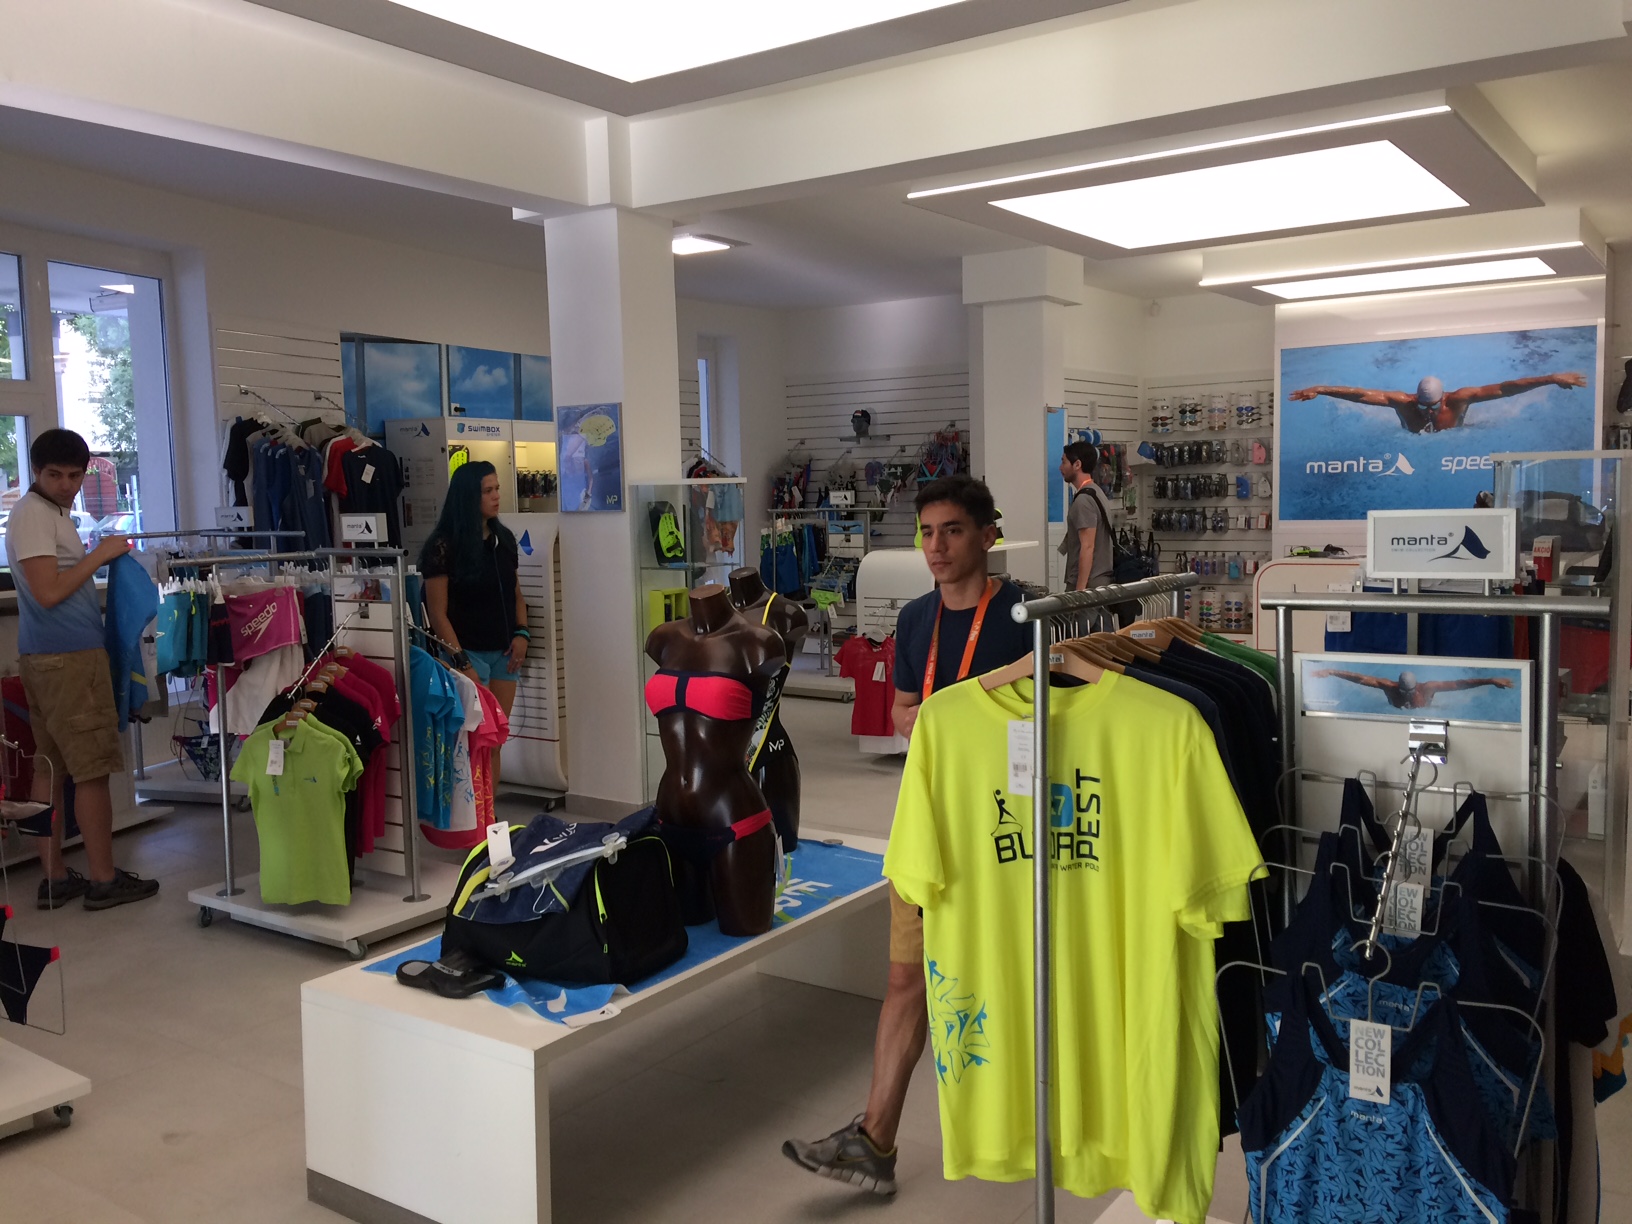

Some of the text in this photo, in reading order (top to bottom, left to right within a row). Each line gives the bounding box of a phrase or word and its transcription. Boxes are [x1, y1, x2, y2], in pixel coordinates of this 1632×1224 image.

[1441, 456, 1494, 474] spee
[241, 602, 277, 637] speedo
[1355, 1026, 1385, 1039] NEW
[1355, 1037, 1385, 1053] COL
[1355, 1050, 1385, 1067] LEC
[1355, 1063, 1385, 1078] TION
